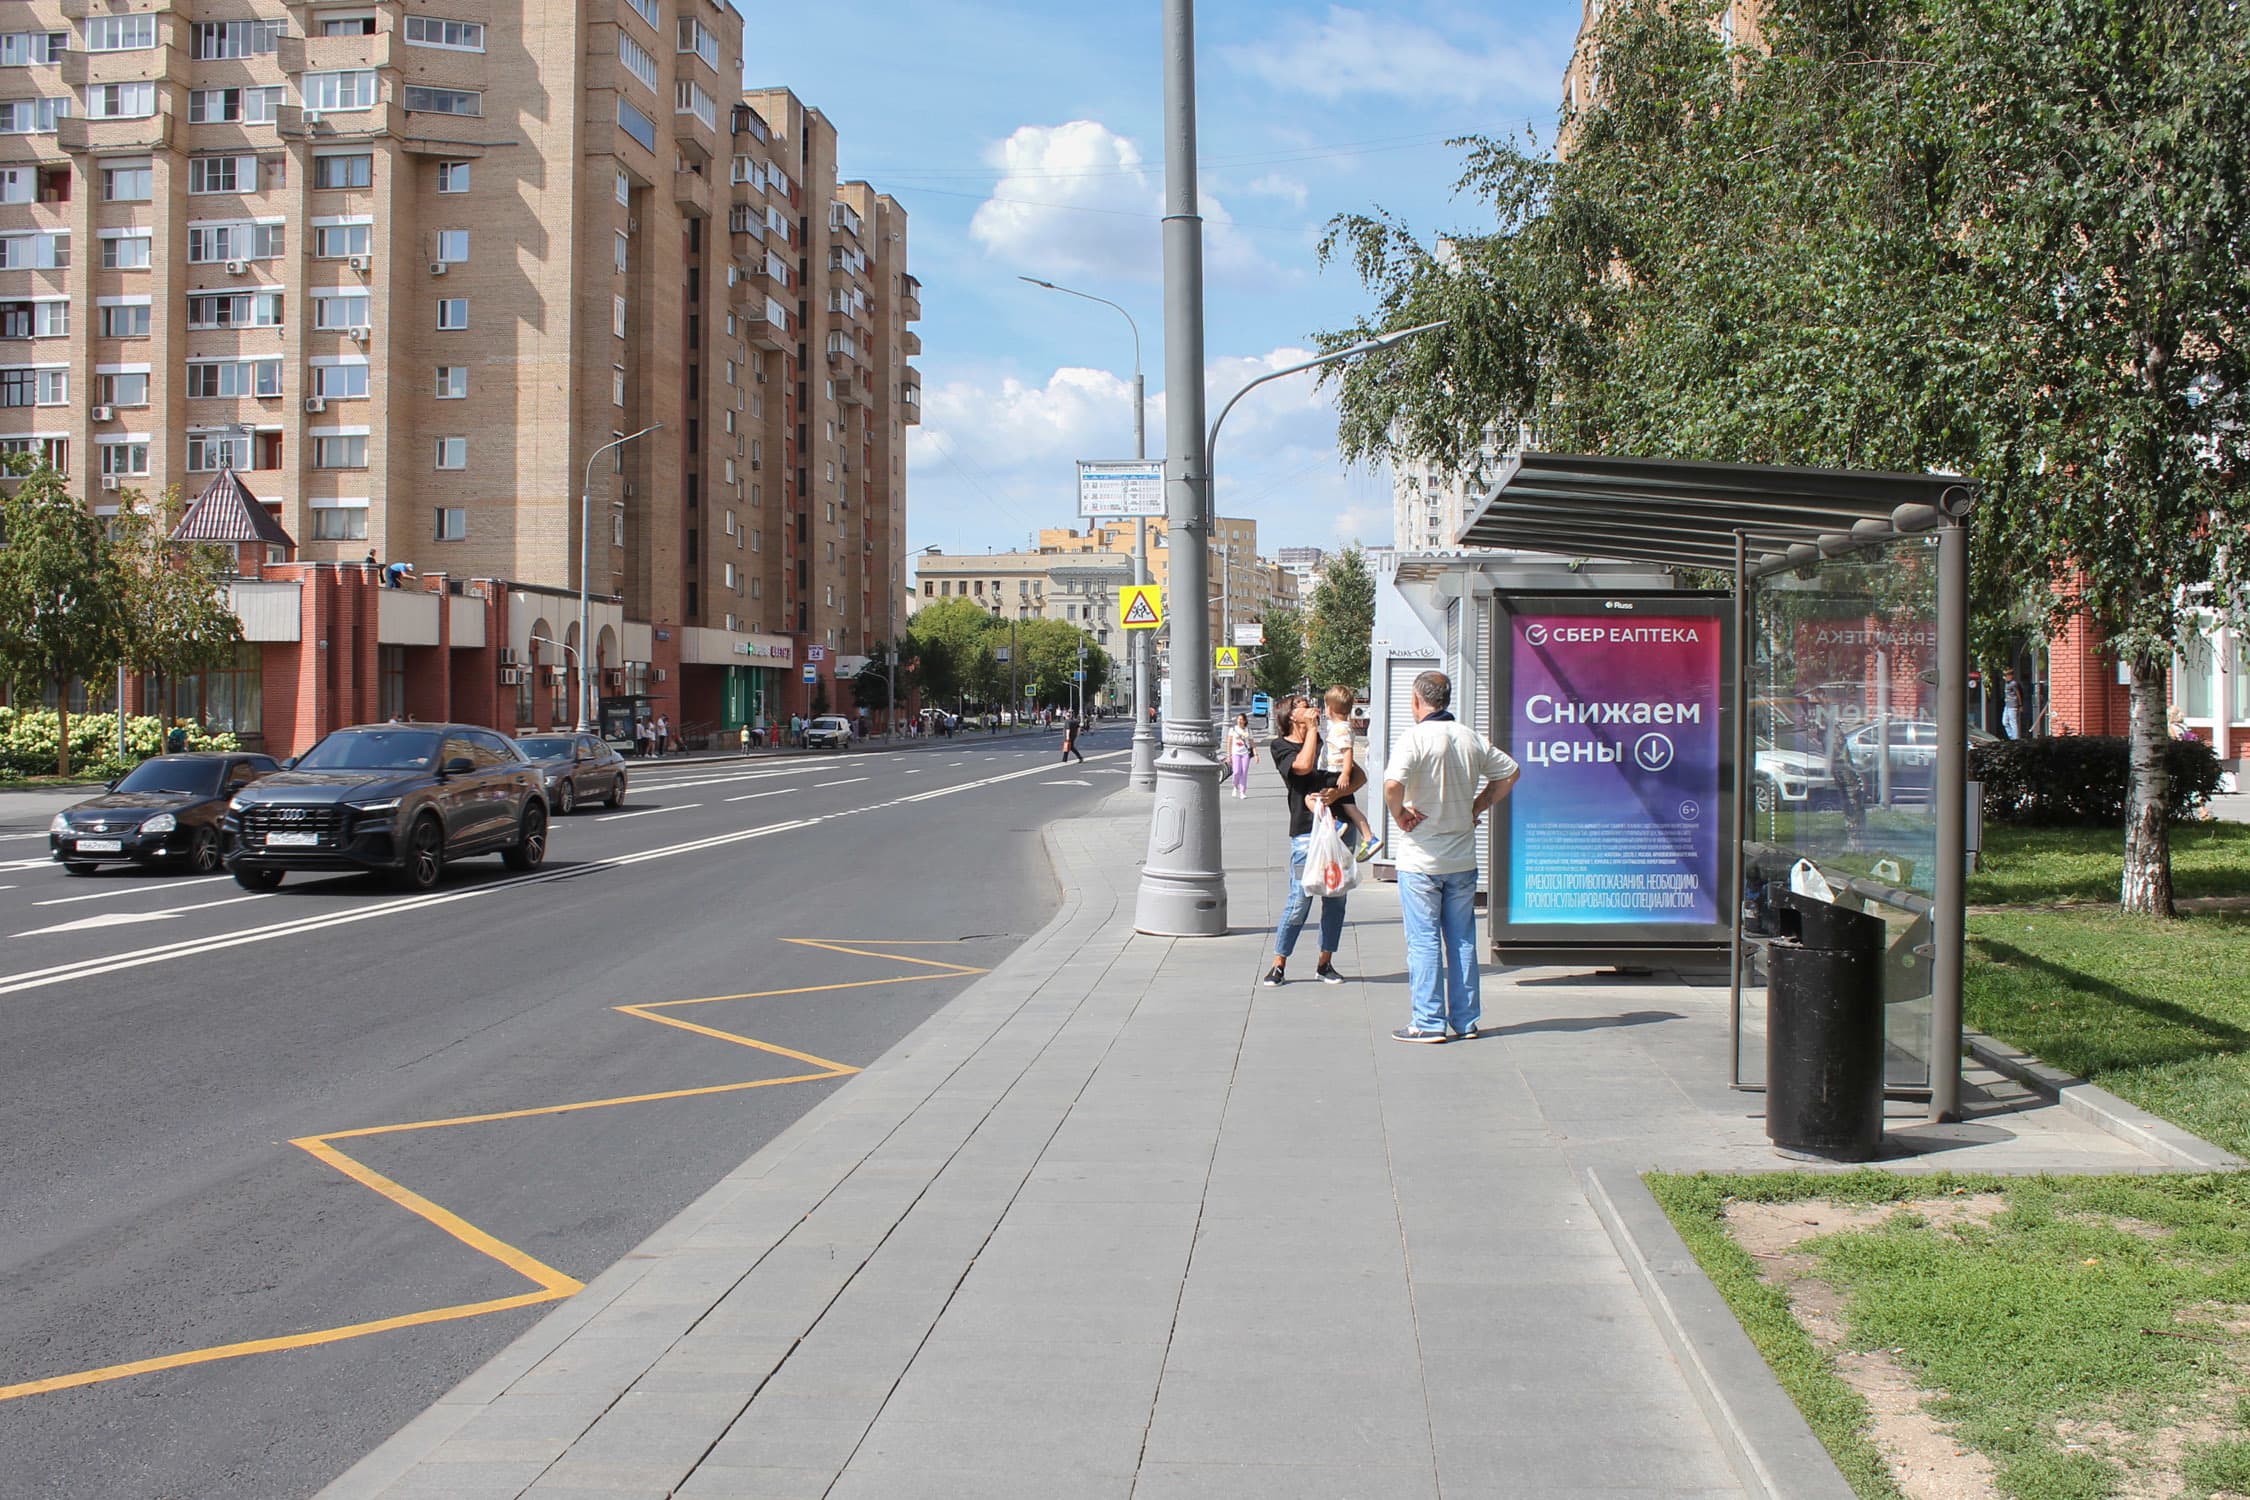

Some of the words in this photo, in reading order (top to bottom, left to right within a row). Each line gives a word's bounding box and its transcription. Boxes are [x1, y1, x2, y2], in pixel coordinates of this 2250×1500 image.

[1613, 601, 1633, 610] Russ
[1553, 627, 1605, 643] СБЕР
[1609, 627, 1700, 643] ЕАПТЕКА
[1525, 694, 1701, 724] Снижаем
[1526, 740, 1623, 768] цены
[1682, 805, 1696, 815] 6+
[1525, 873, 1562, 890] ИМЕЮТСЯ
[1563, 873, 1645, 890] ПРОТИВОПОКАЗАНИЯ.
[1646, 873, 1699, 892] НЕОБХОДИМО
[1525, 892, 1620, 908] ПРОКОНСУЛЬТИРОВАТЬСЯ
[1620, 892, 1631, 908] СО
[1632, 892, 1696, 911] СПЕЦИАЛИСТОМ.
